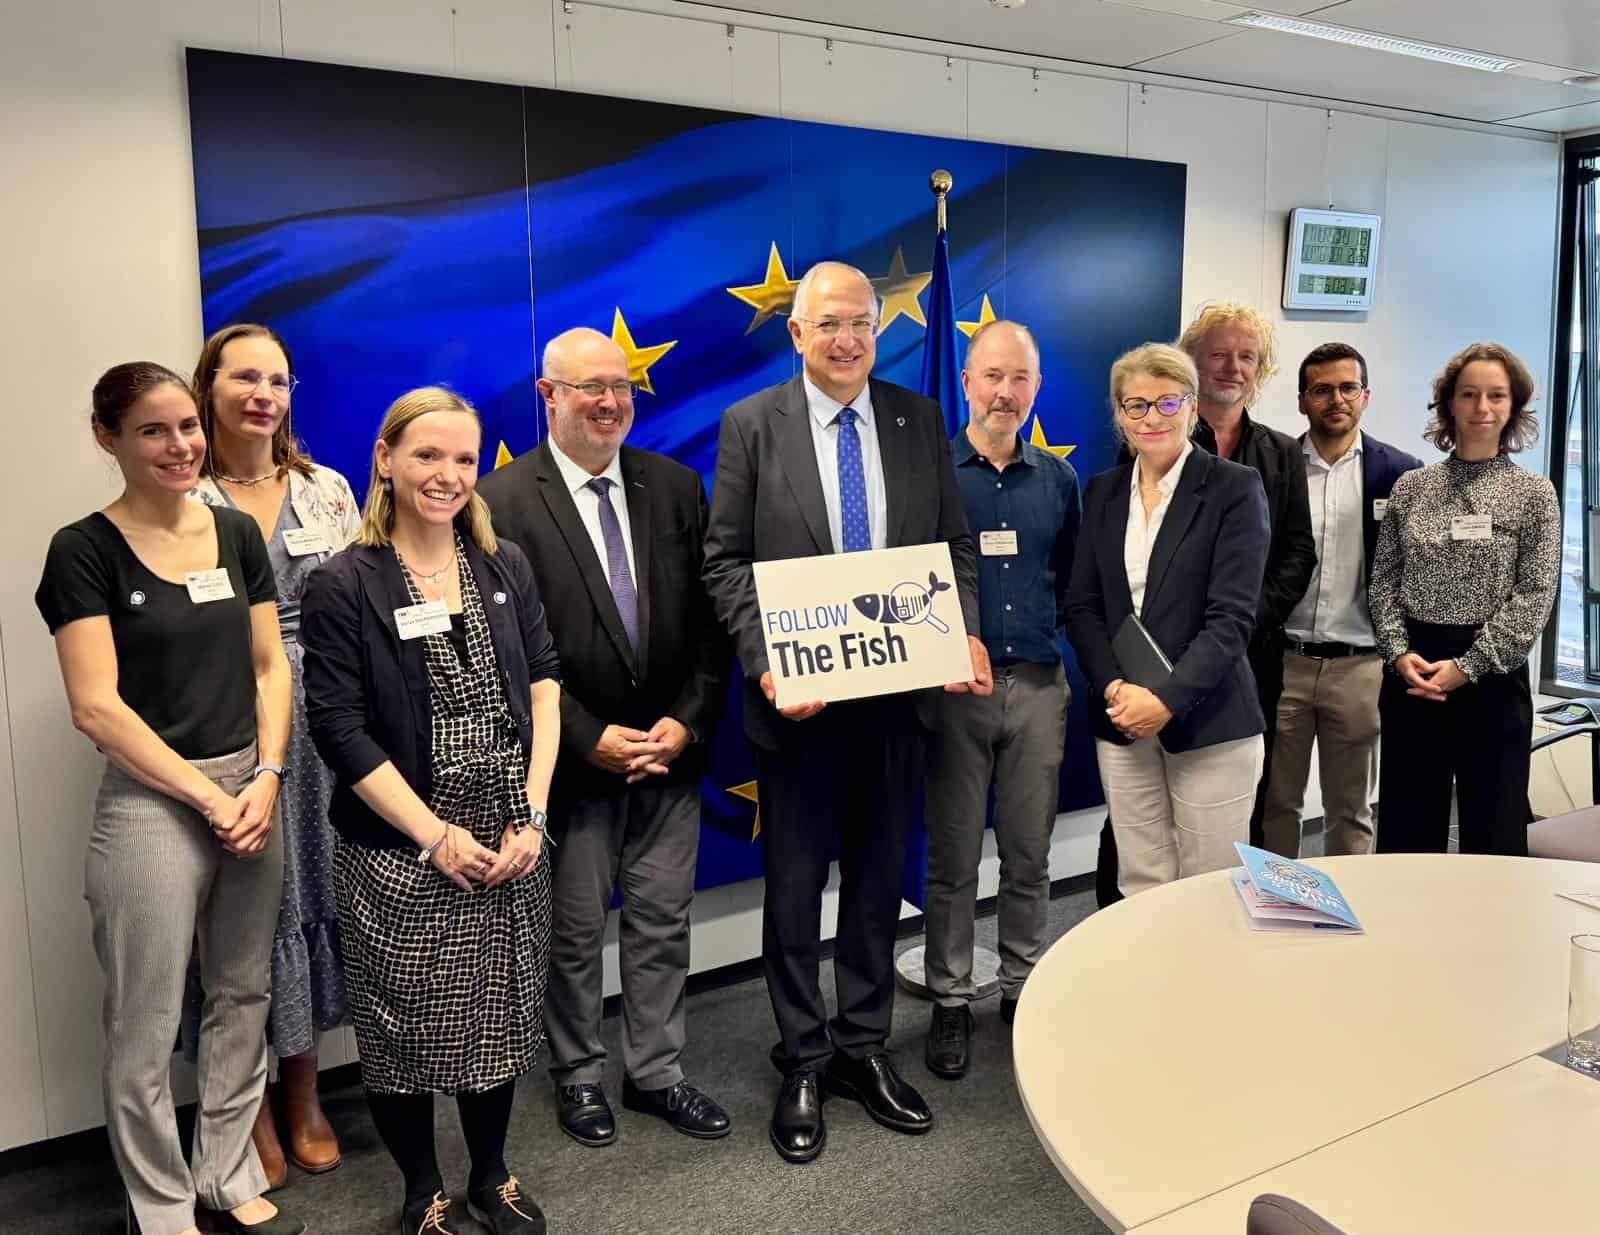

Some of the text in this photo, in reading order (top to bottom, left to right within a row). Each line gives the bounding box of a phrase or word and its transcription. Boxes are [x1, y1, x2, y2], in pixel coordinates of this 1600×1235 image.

[766, 603, 848, 634] FOLLOW
[771, 625, 908, 678] The Fish
